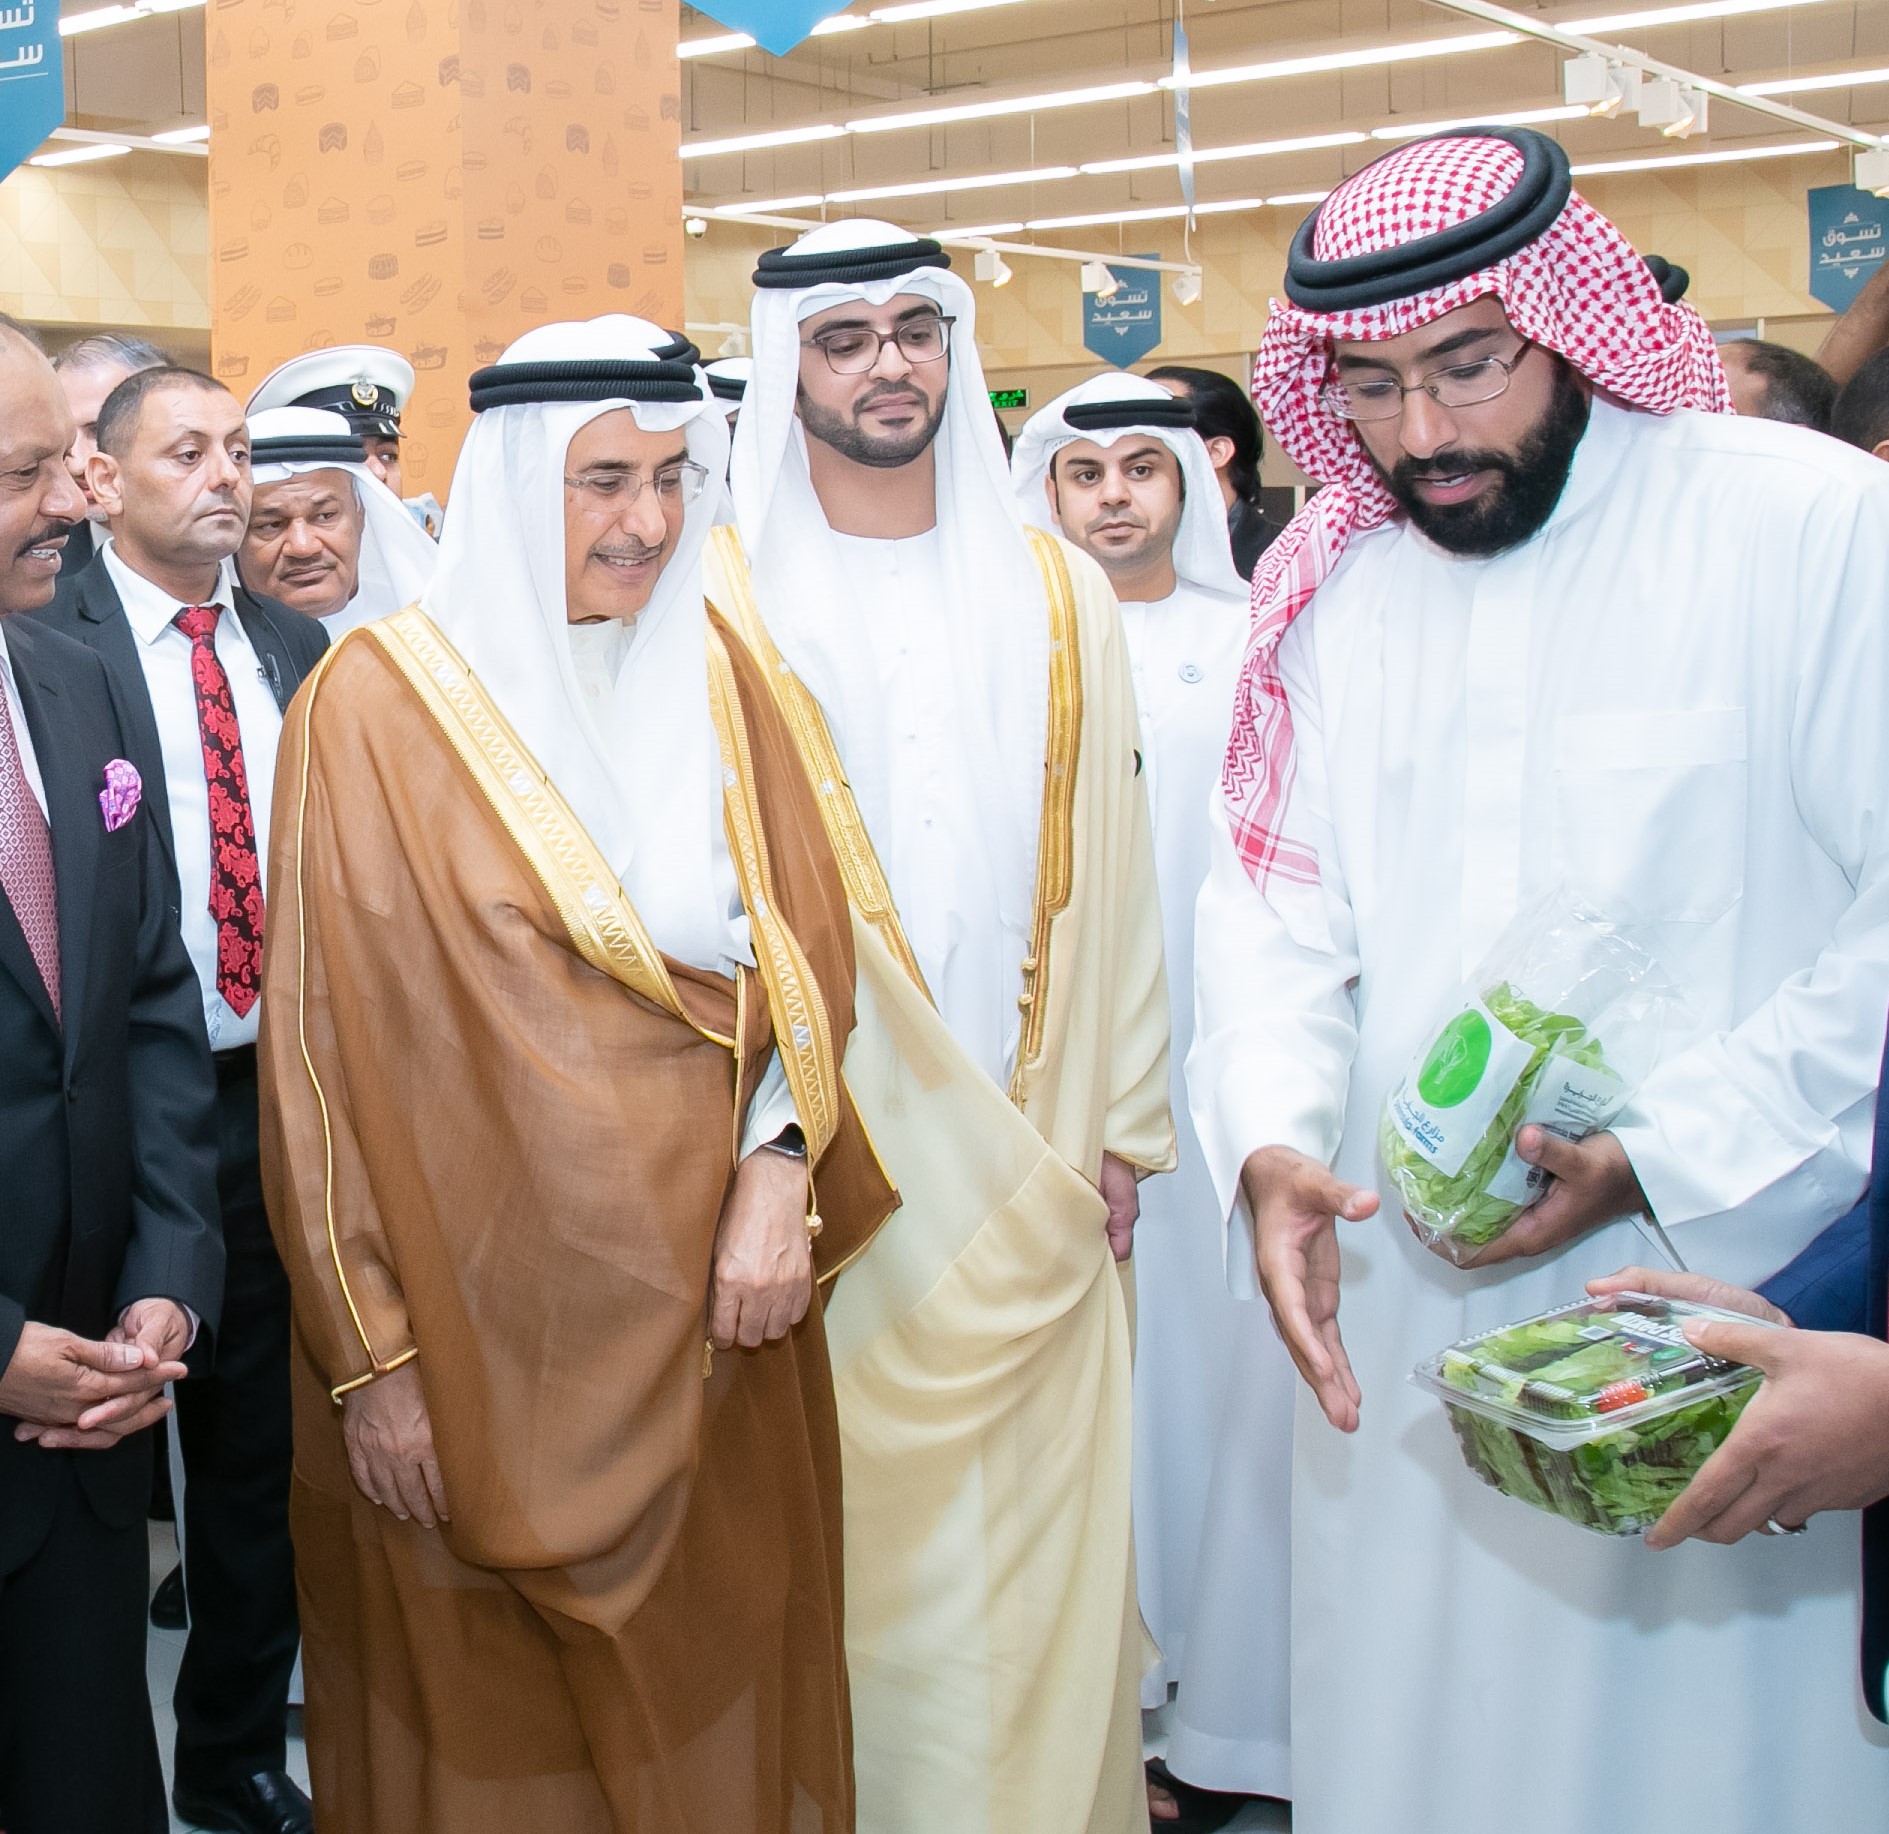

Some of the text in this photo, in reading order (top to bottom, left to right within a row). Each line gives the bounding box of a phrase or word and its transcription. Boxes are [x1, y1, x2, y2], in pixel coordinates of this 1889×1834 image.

[1821, 223, 1881, 247] تسوق
[1818, 246, 1886, 267] سعيد
[1091, 309, 1153, 325] سعيد
[1412, 1126, 1439, 1154] farms
